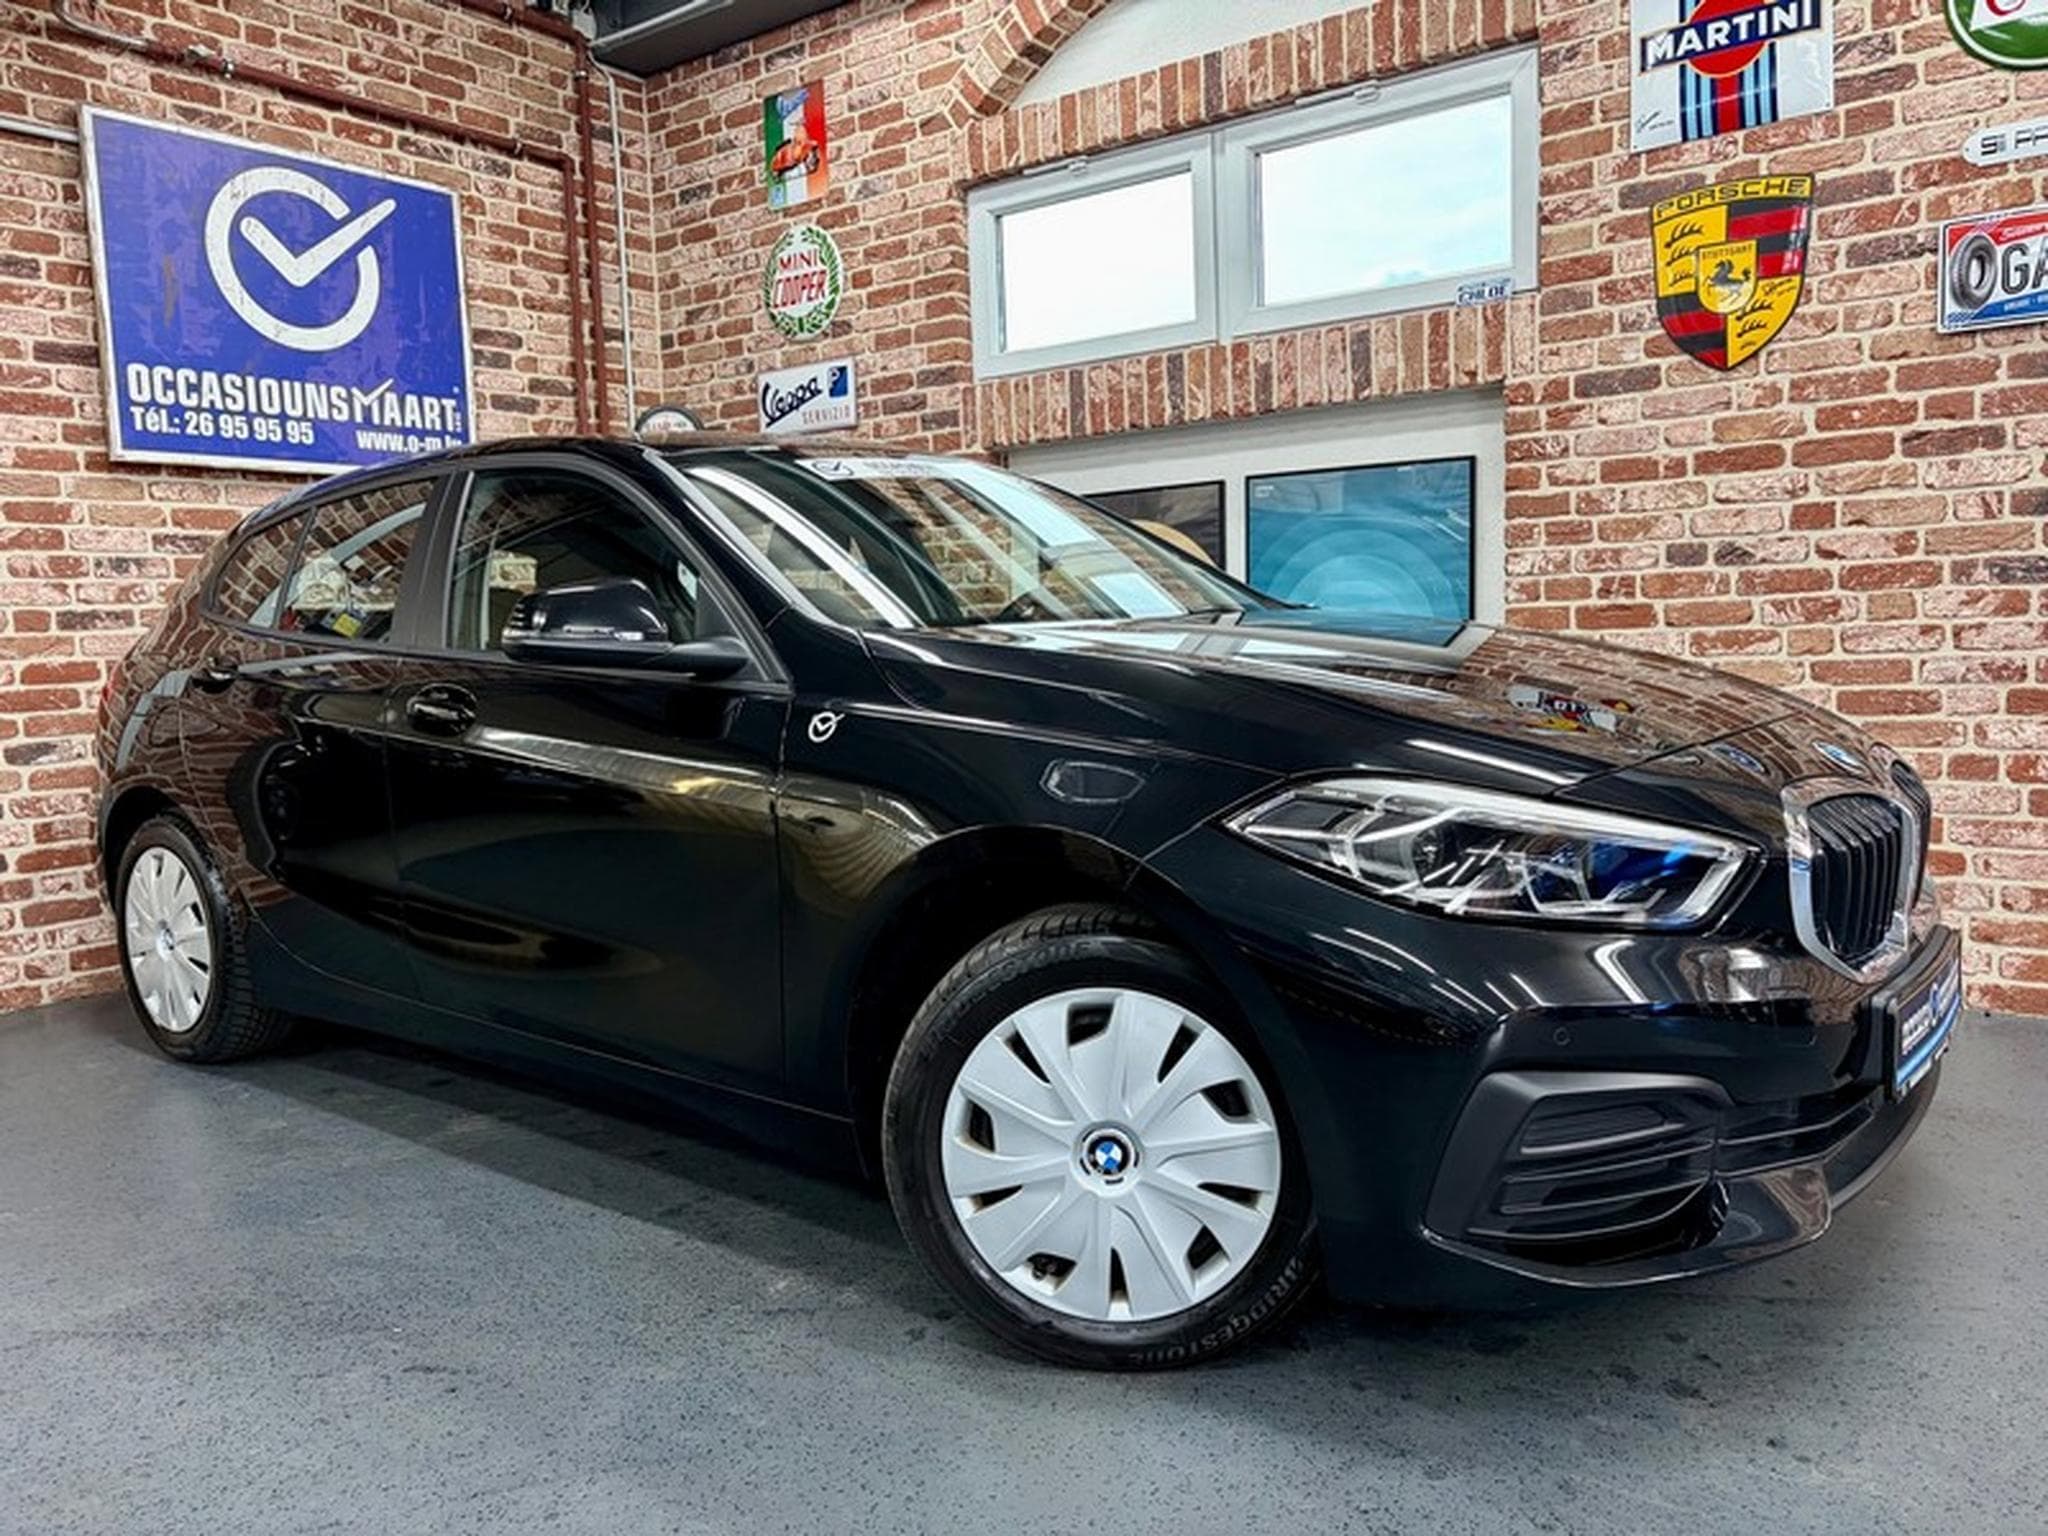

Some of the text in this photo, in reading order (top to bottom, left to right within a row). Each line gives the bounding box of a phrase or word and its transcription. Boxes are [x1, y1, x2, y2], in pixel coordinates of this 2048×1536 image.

[1646, 0, 1812, 68] MARTINI
[1657, 178, 1808, 218] PORSCHE
[779, 247, 818, 271] MINI
[773, 269, 827, 309] COOPER
[127, 362, 457, 433] OCCASIOUNSMAART
[762, 376, 824, 428] Vespa
[130, 406, 315, 446] Tél.: 26 95 95 95
[355, 430, 462, 453] www.o-mlu
